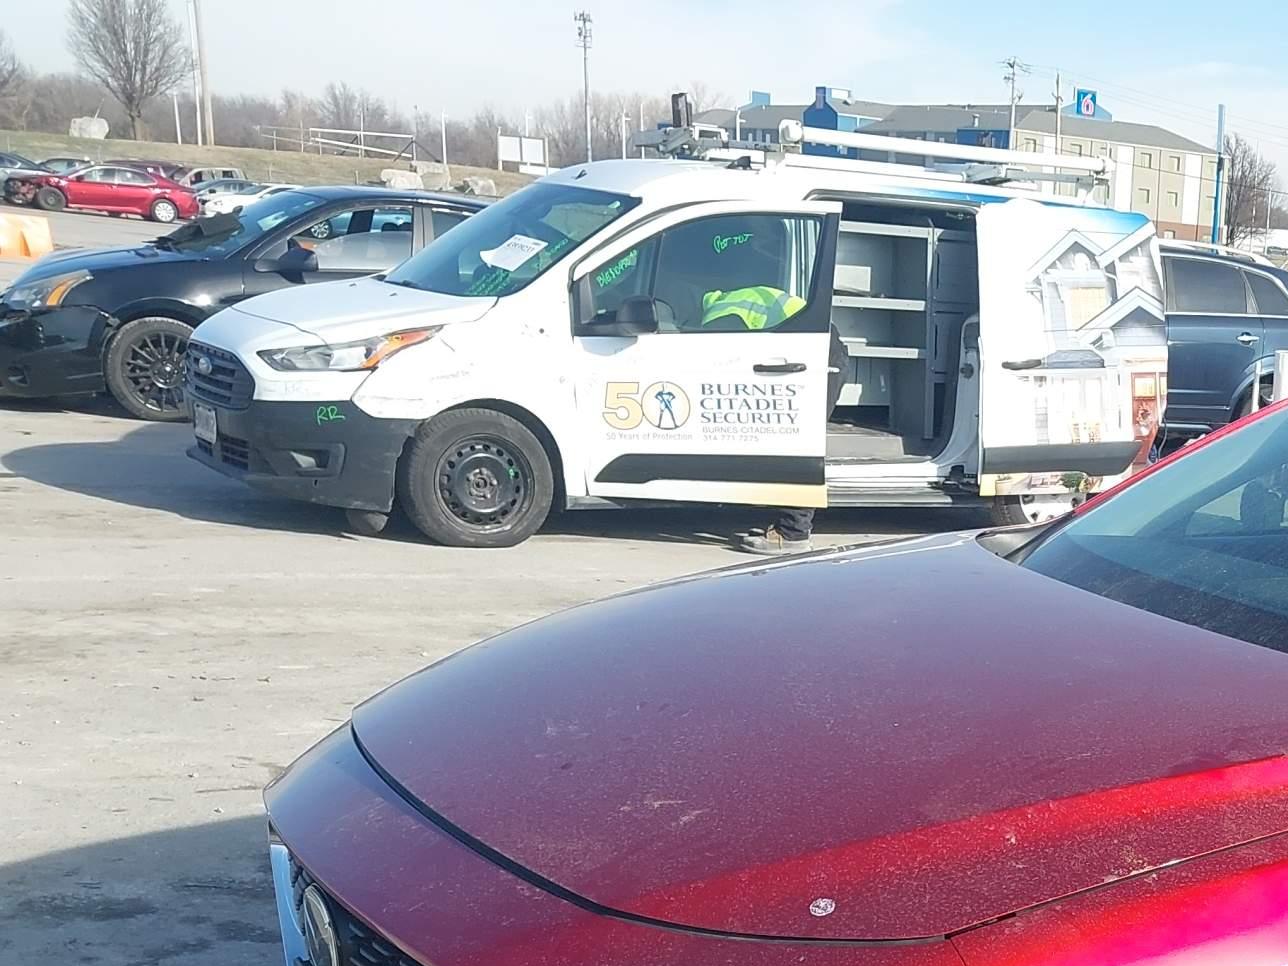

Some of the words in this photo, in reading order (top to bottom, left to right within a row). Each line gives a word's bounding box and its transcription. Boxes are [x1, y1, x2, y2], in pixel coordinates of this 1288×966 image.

[701, 383, 797, 396] BURNES
[700, 398, 799, 411] CITADEL
[701, 412, 799, 424] SECURITY
[652, 433, 693, 441] Protection
